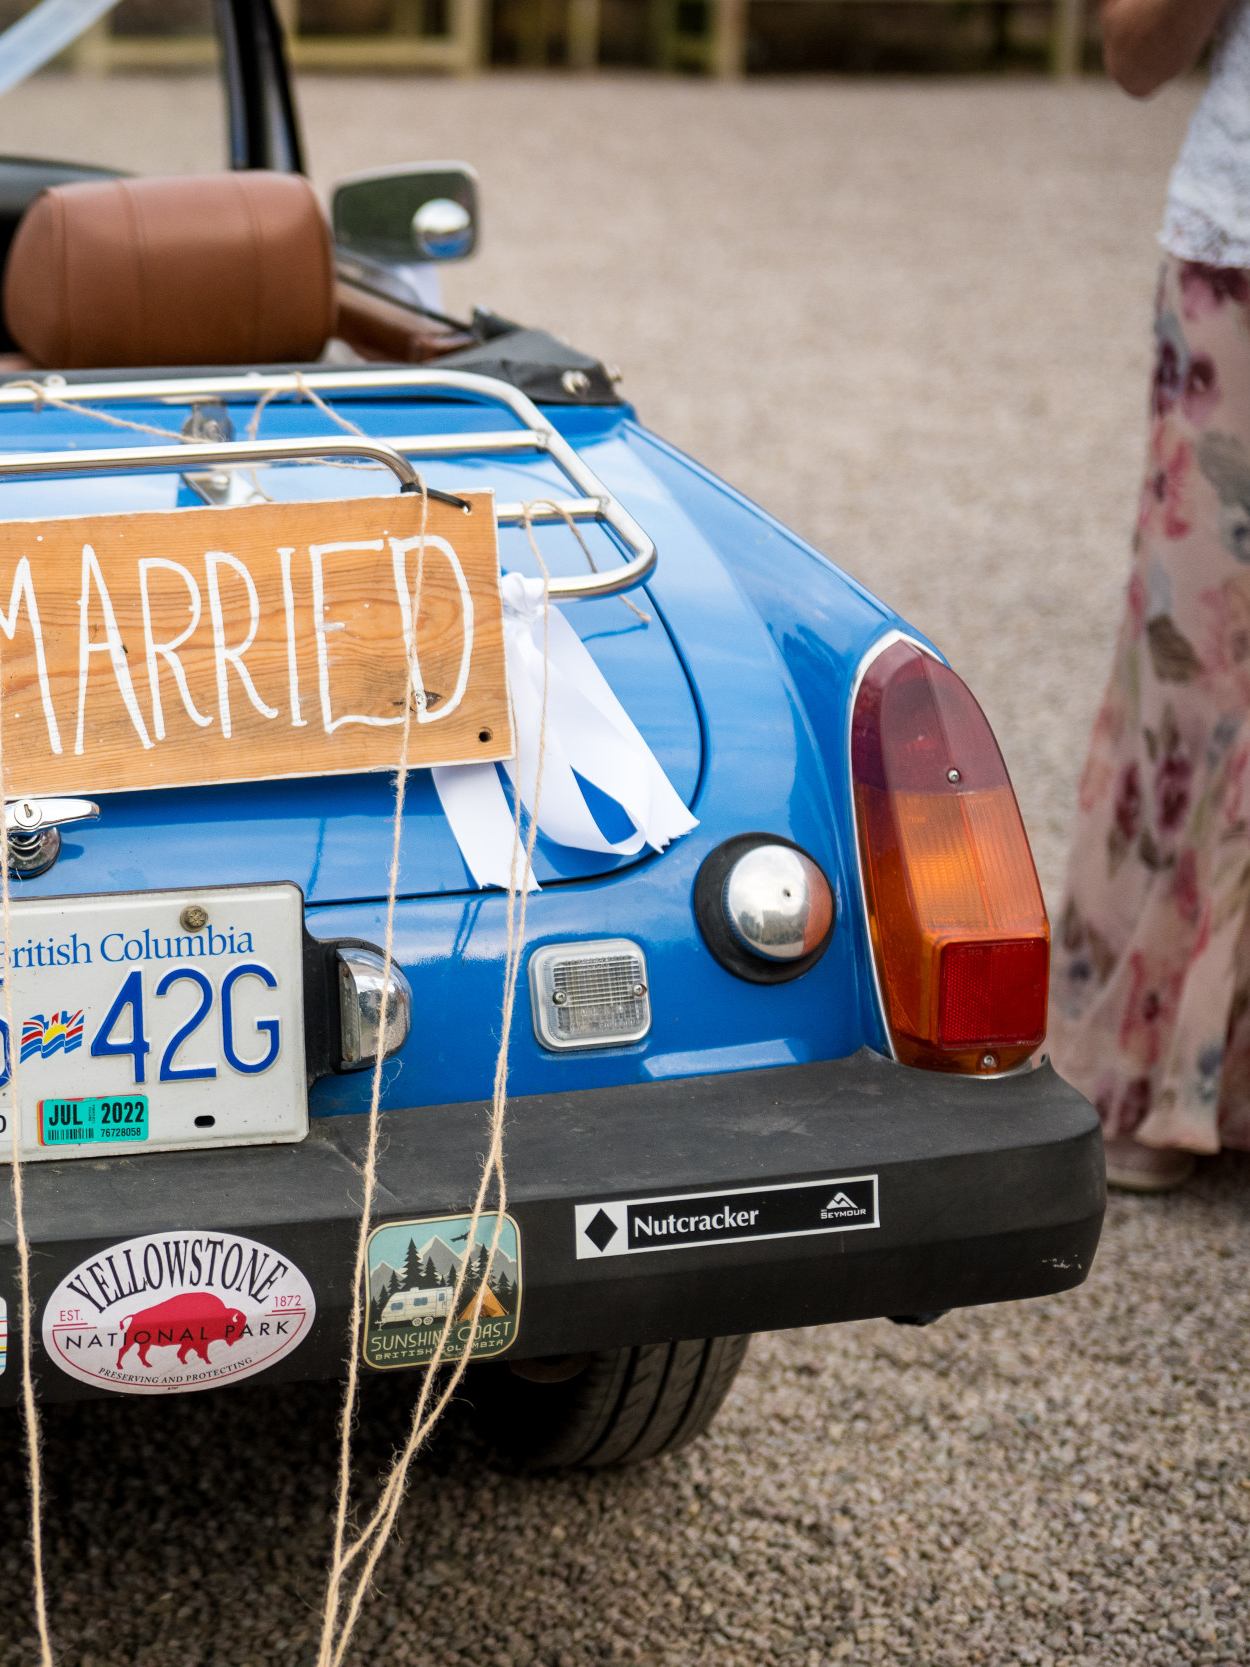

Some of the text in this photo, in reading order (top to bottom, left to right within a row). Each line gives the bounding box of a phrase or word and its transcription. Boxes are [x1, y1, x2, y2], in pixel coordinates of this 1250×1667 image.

[100, 926, 256, 964] Columbia
[90, 964, 282, 1084] 42G
[48, 1104, 84, 1126] JUL
[101, 1101, 145, 1124] 2022
[100, 1127, 142, 1138] 76728058
[634, 1205, 760, 1238] Nutcracker
[820, 1208, 867, 1220] SEYMOUR
[66, 1237, 289, 1314] YELLOWSTONE
[59, 1294, 302, 1322] EST. 1872
[65, 1320, 290, 1350] NATIONAL PARK
[457, 1321, 512, 1341] COAST
[375, 1348, 433, 1361] BRITISH
[98, 1357, 253, 1384] PRESERVING AND PROTECTING
